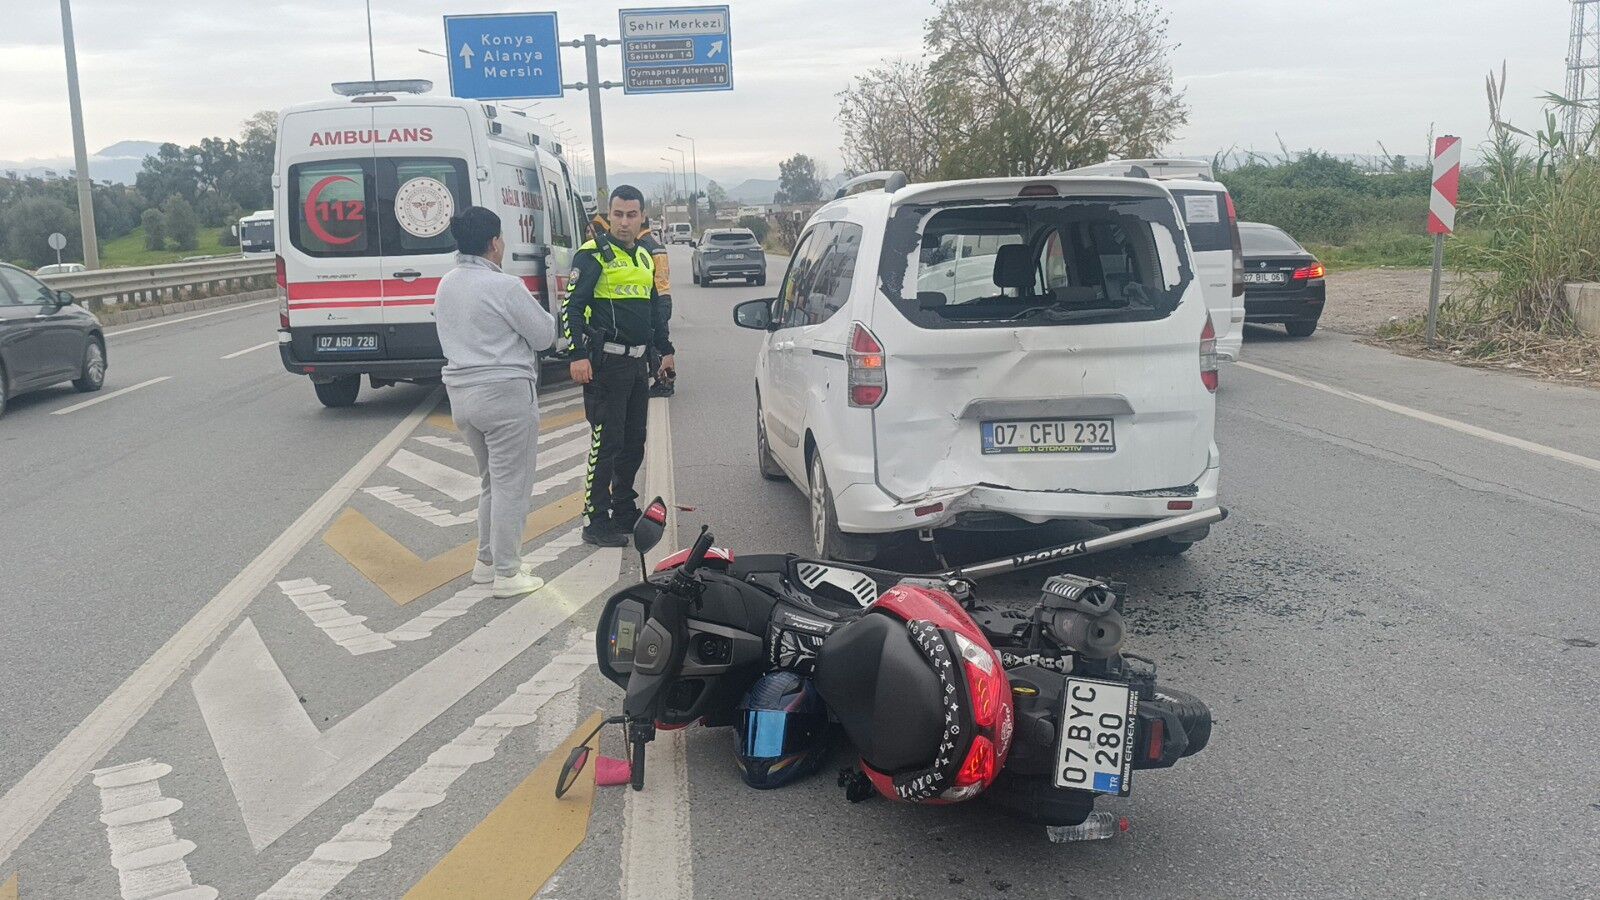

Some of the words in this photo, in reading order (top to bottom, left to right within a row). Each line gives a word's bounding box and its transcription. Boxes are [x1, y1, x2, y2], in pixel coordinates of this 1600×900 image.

[629, 20, 664, 31] Şehir
[669, 18, 721, 29] Merkezi
[481, 33, 534, 47] Konya
[484, 50, 543, 63] Alanya
[484, 66, 543, 78] Mersin
[682, 66, 725, 74] Alternatif
[631, 78, 662, 86] Turizm
[309, 127, 435, 146] AMBULANS
[317, 200, 365, 222] 112
[519, 214, 536, 243] 112
[321, 336, 333, 347] 07
[357, 336, 375, 347] 728
[995, 424, 1018, 445] 07
[1030, 423, 1066, 444] CFU
[1074, 422, 1110, 444] 232
[1068, 685, 1097, 742] BYC
[1095, 713, 1123, 768] 280
[1124, 717, 1136, 762] ERDEM
[1063, 747, 1088, 784] 07
[1110, 776, 1119, 788] TR
